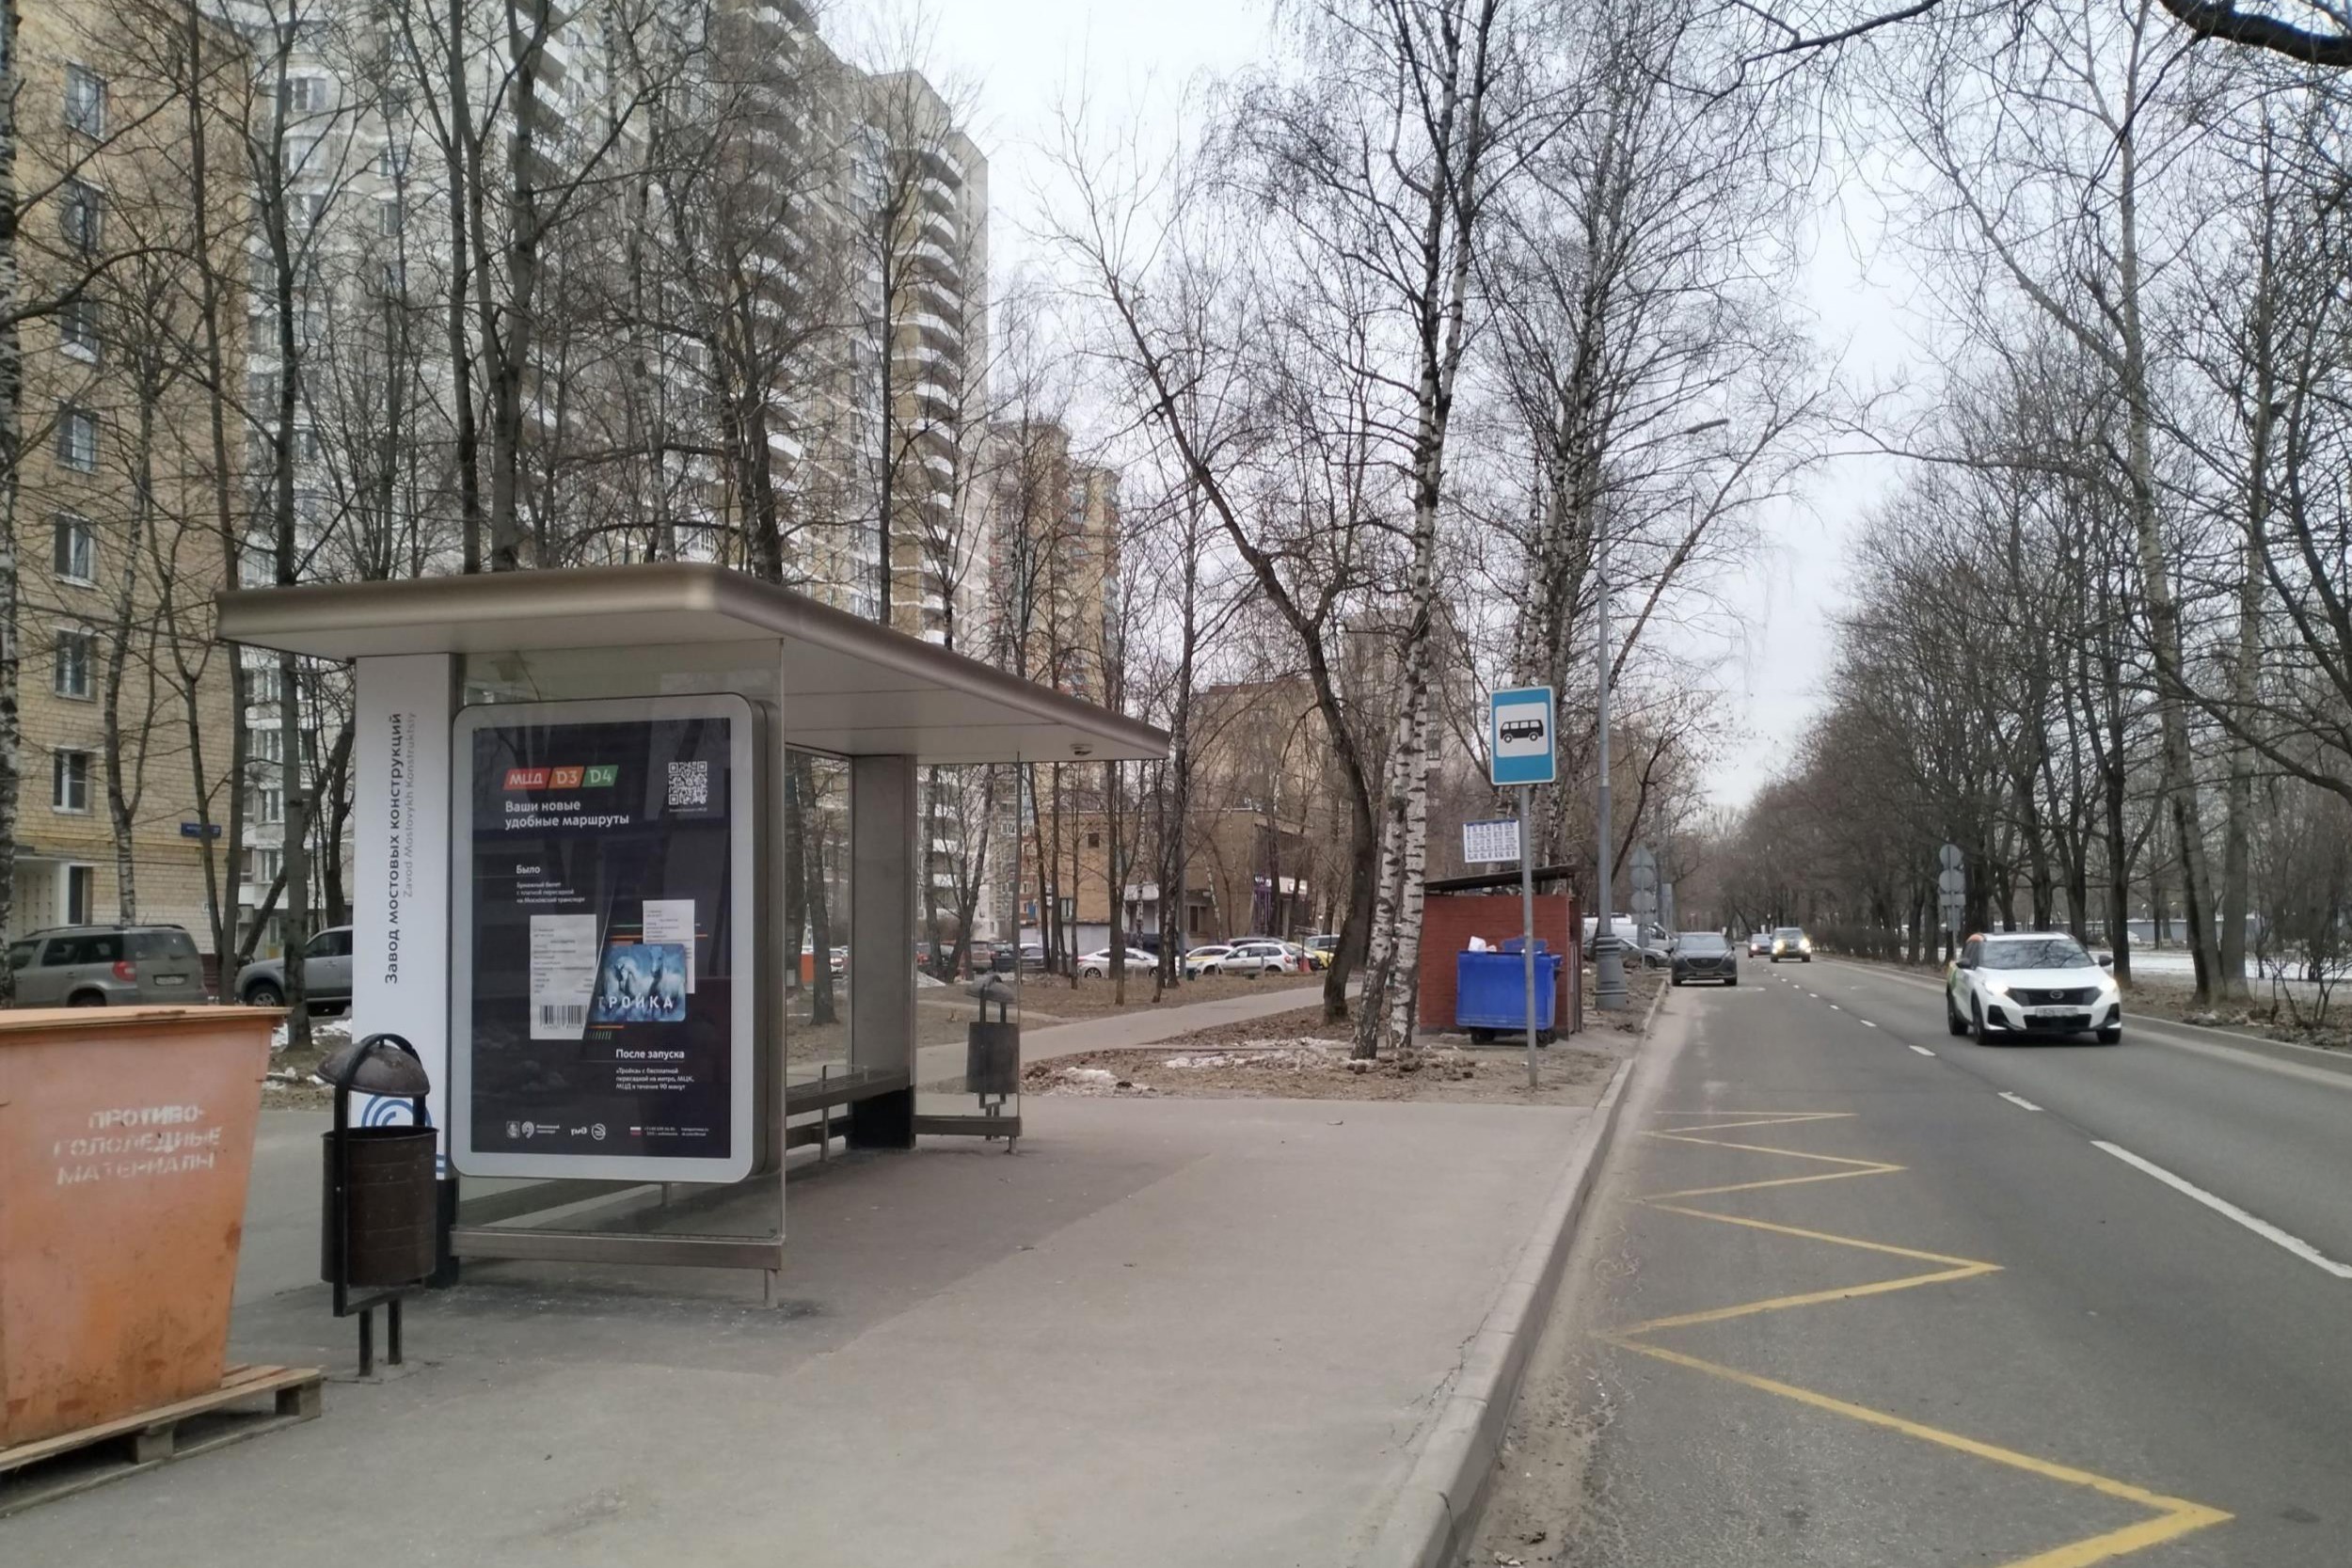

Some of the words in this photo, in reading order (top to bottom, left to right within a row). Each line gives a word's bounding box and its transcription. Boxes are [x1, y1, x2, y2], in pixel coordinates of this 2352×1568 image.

[405, 712, 416, 788] Konstruktsiy
[389, 713, 404, 830] конструкций
[509, 770, 543, 785] МЦД
[556, 769, 578, 784] D3
[589, 768, 612, 784] D4
[505, 800, 538, 813] Ваши
[541, 800, 581, 812] новые
[505, 816, 559, 831] удобные
[562, 814, 629, 829] маршруты
[405, 791, 416, 858] Mostovykh
[389, 834, 400, 925] мостовых
[404, 862, 413, 898] Zavod
[516, 864, 541, 875] Было
[385, 929, 400, 984] Завод
[615, 1049, 645, 1059] После
[647, 1051, 685, 1060] запуска
[88, 1104, 205, 1129] ПРОТИВО-
[54, 1126, 223, 1158] ГОЛОЛЕДНЫЕ
